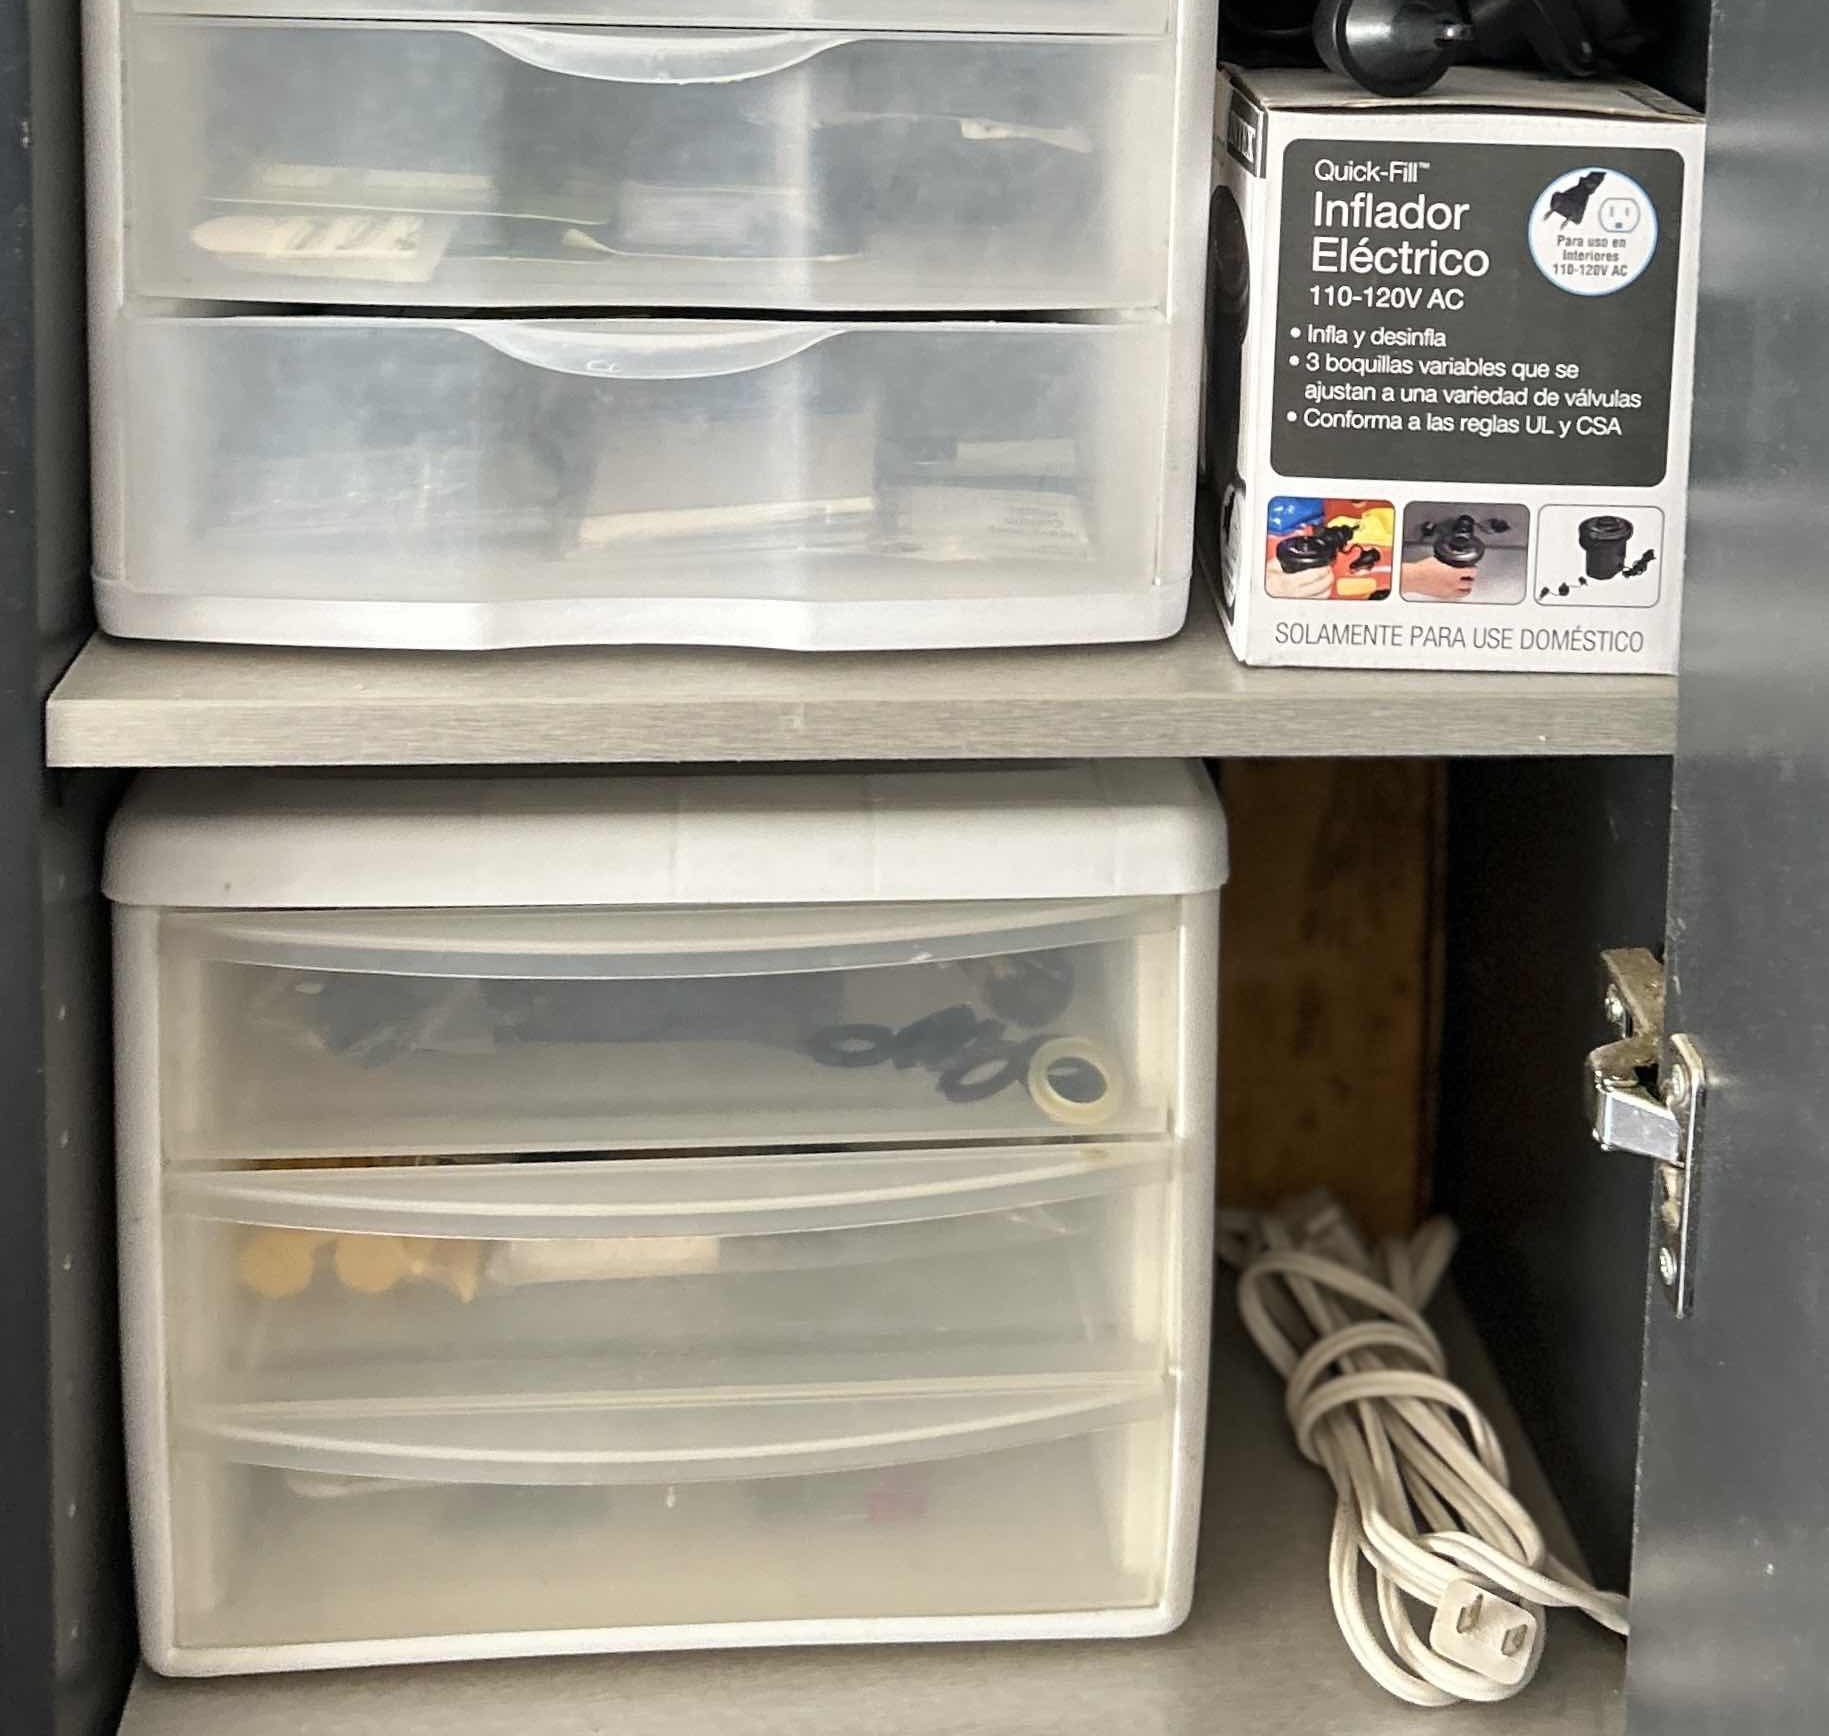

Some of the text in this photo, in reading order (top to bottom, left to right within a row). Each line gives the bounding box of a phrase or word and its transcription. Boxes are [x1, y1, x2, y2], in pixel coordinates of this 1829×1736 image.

[1313, 190, 1471, 230] Inflador
[1556, 234, 1626, 248] Para uso en
[1312, 236, 1490, 277] Eléctrico
[1553, 263, 1628, 276] 110-120V AC
[1562, 249, 1619, 262] Interiores
[1309, 284, 1465, 310] 110-120V AC
[1307, 324, 1447, 348] Infla y desinfla
[1305, 352, 1580, 381] 3 boquillas variables que se
[1304, 381, 1643, 409] ajustan a una variedad de válvulas
[1303, 408, 1622, 439] Conforma a las reglas UL y CSA
[1275, 621, 1645, 653] SOLAMENTE PARA USE DOMÉSTICO
